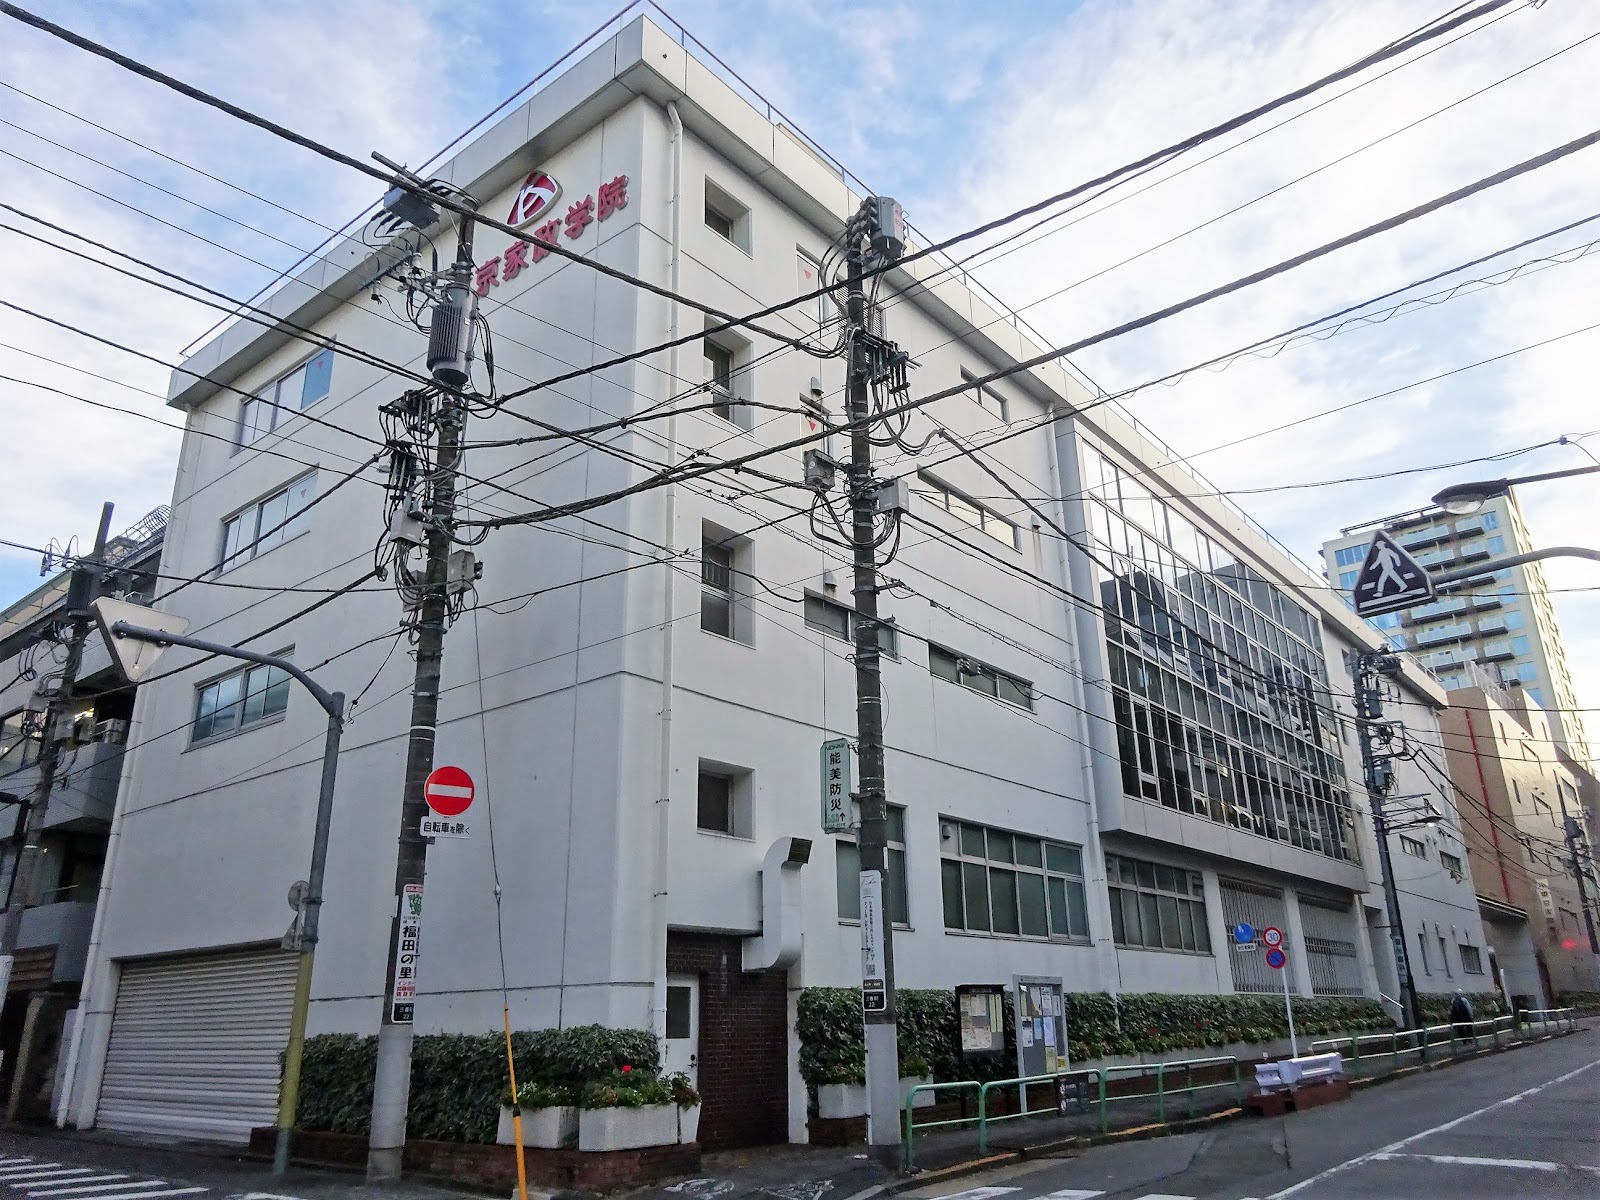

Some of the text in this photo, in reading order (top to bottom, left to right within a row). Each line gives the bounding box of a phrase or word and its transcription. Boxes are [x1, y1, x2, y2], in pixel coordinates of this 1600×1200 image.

[829, 752, 842, 812] 能美防災
[423, 821, 470, 835] 自転車を除く
[398, 925, 417, 979] 福田の里
[1267, 932, 1279, 942] 30
